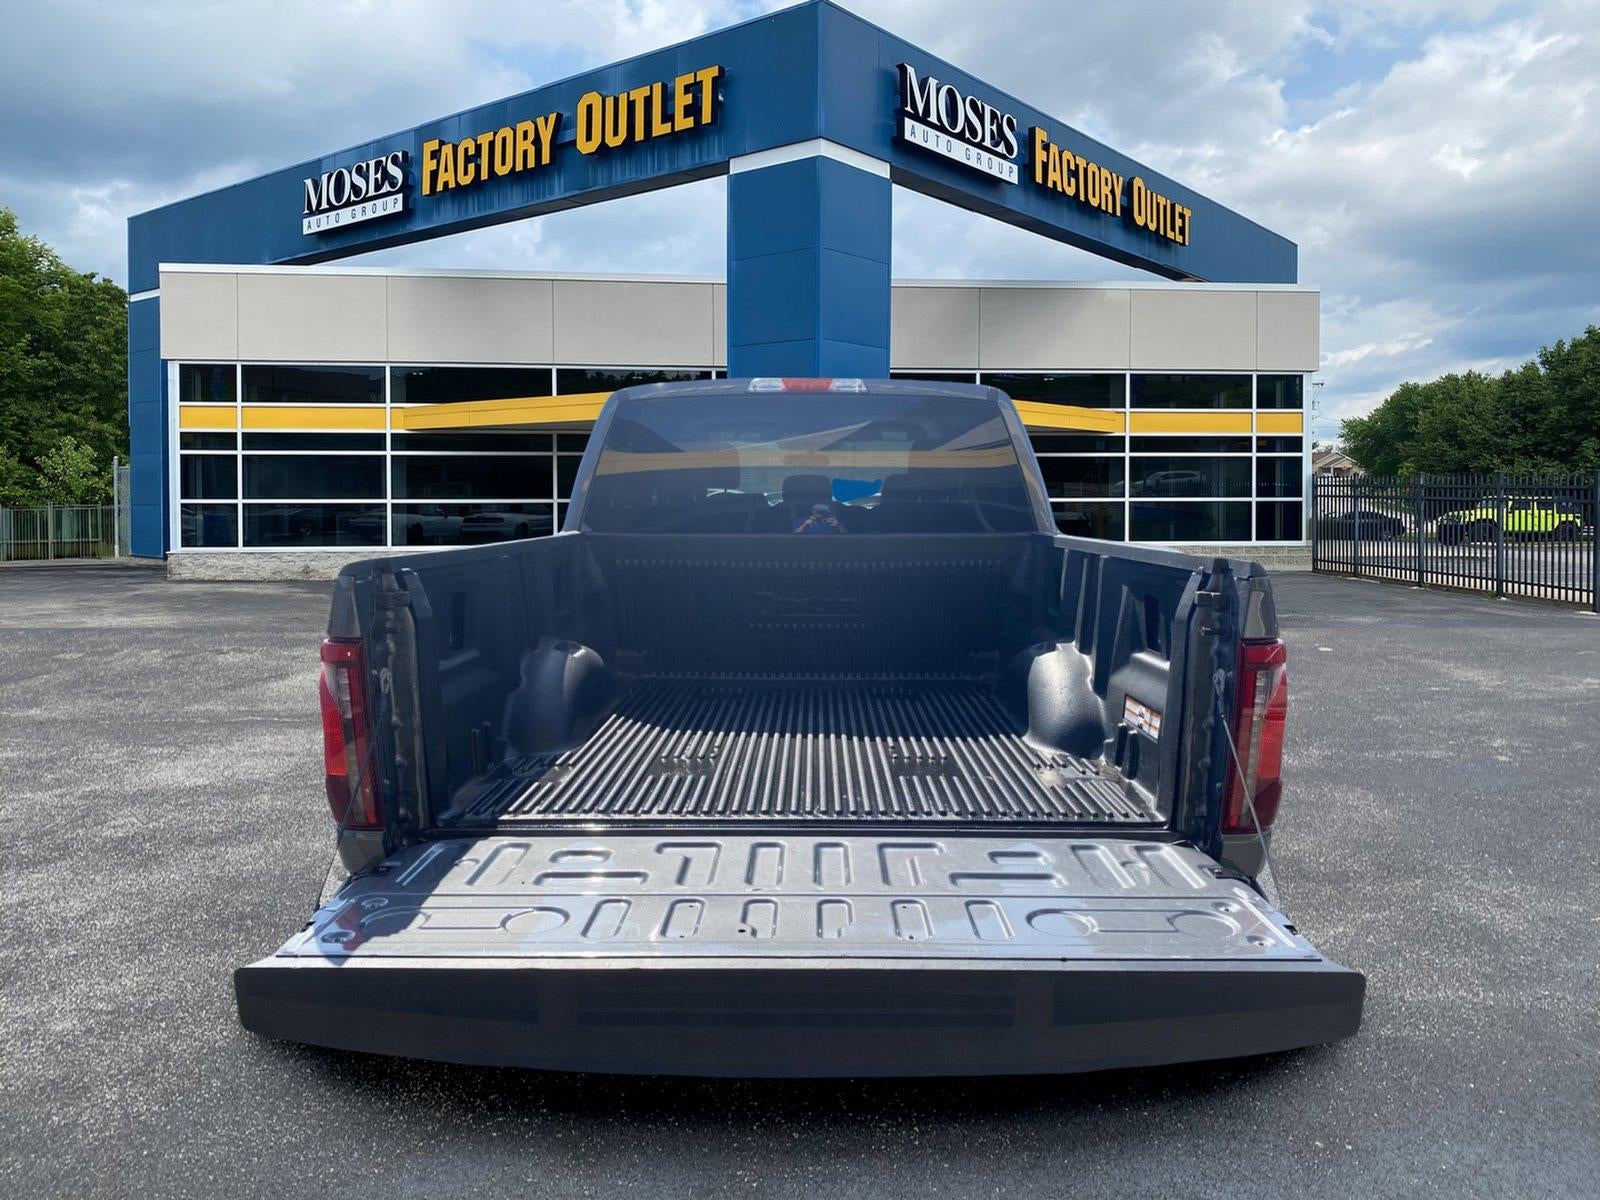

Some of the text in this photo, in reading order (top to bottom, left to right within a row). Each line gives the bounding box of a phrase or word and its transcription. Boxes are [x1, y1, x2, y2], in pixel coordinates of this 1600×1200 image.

[421, 65, 720, 196] FACTORY OUTLET
[904, 63, 1018, 159] MOSES
[303, 151, 403, 214] MOSES
[910, 125, 1014, 178] AUTO GROUP
[1034, 126, 1192, 247] FACTORY OUTLET
[307, 198, 399, 230] AUTO GROUP
